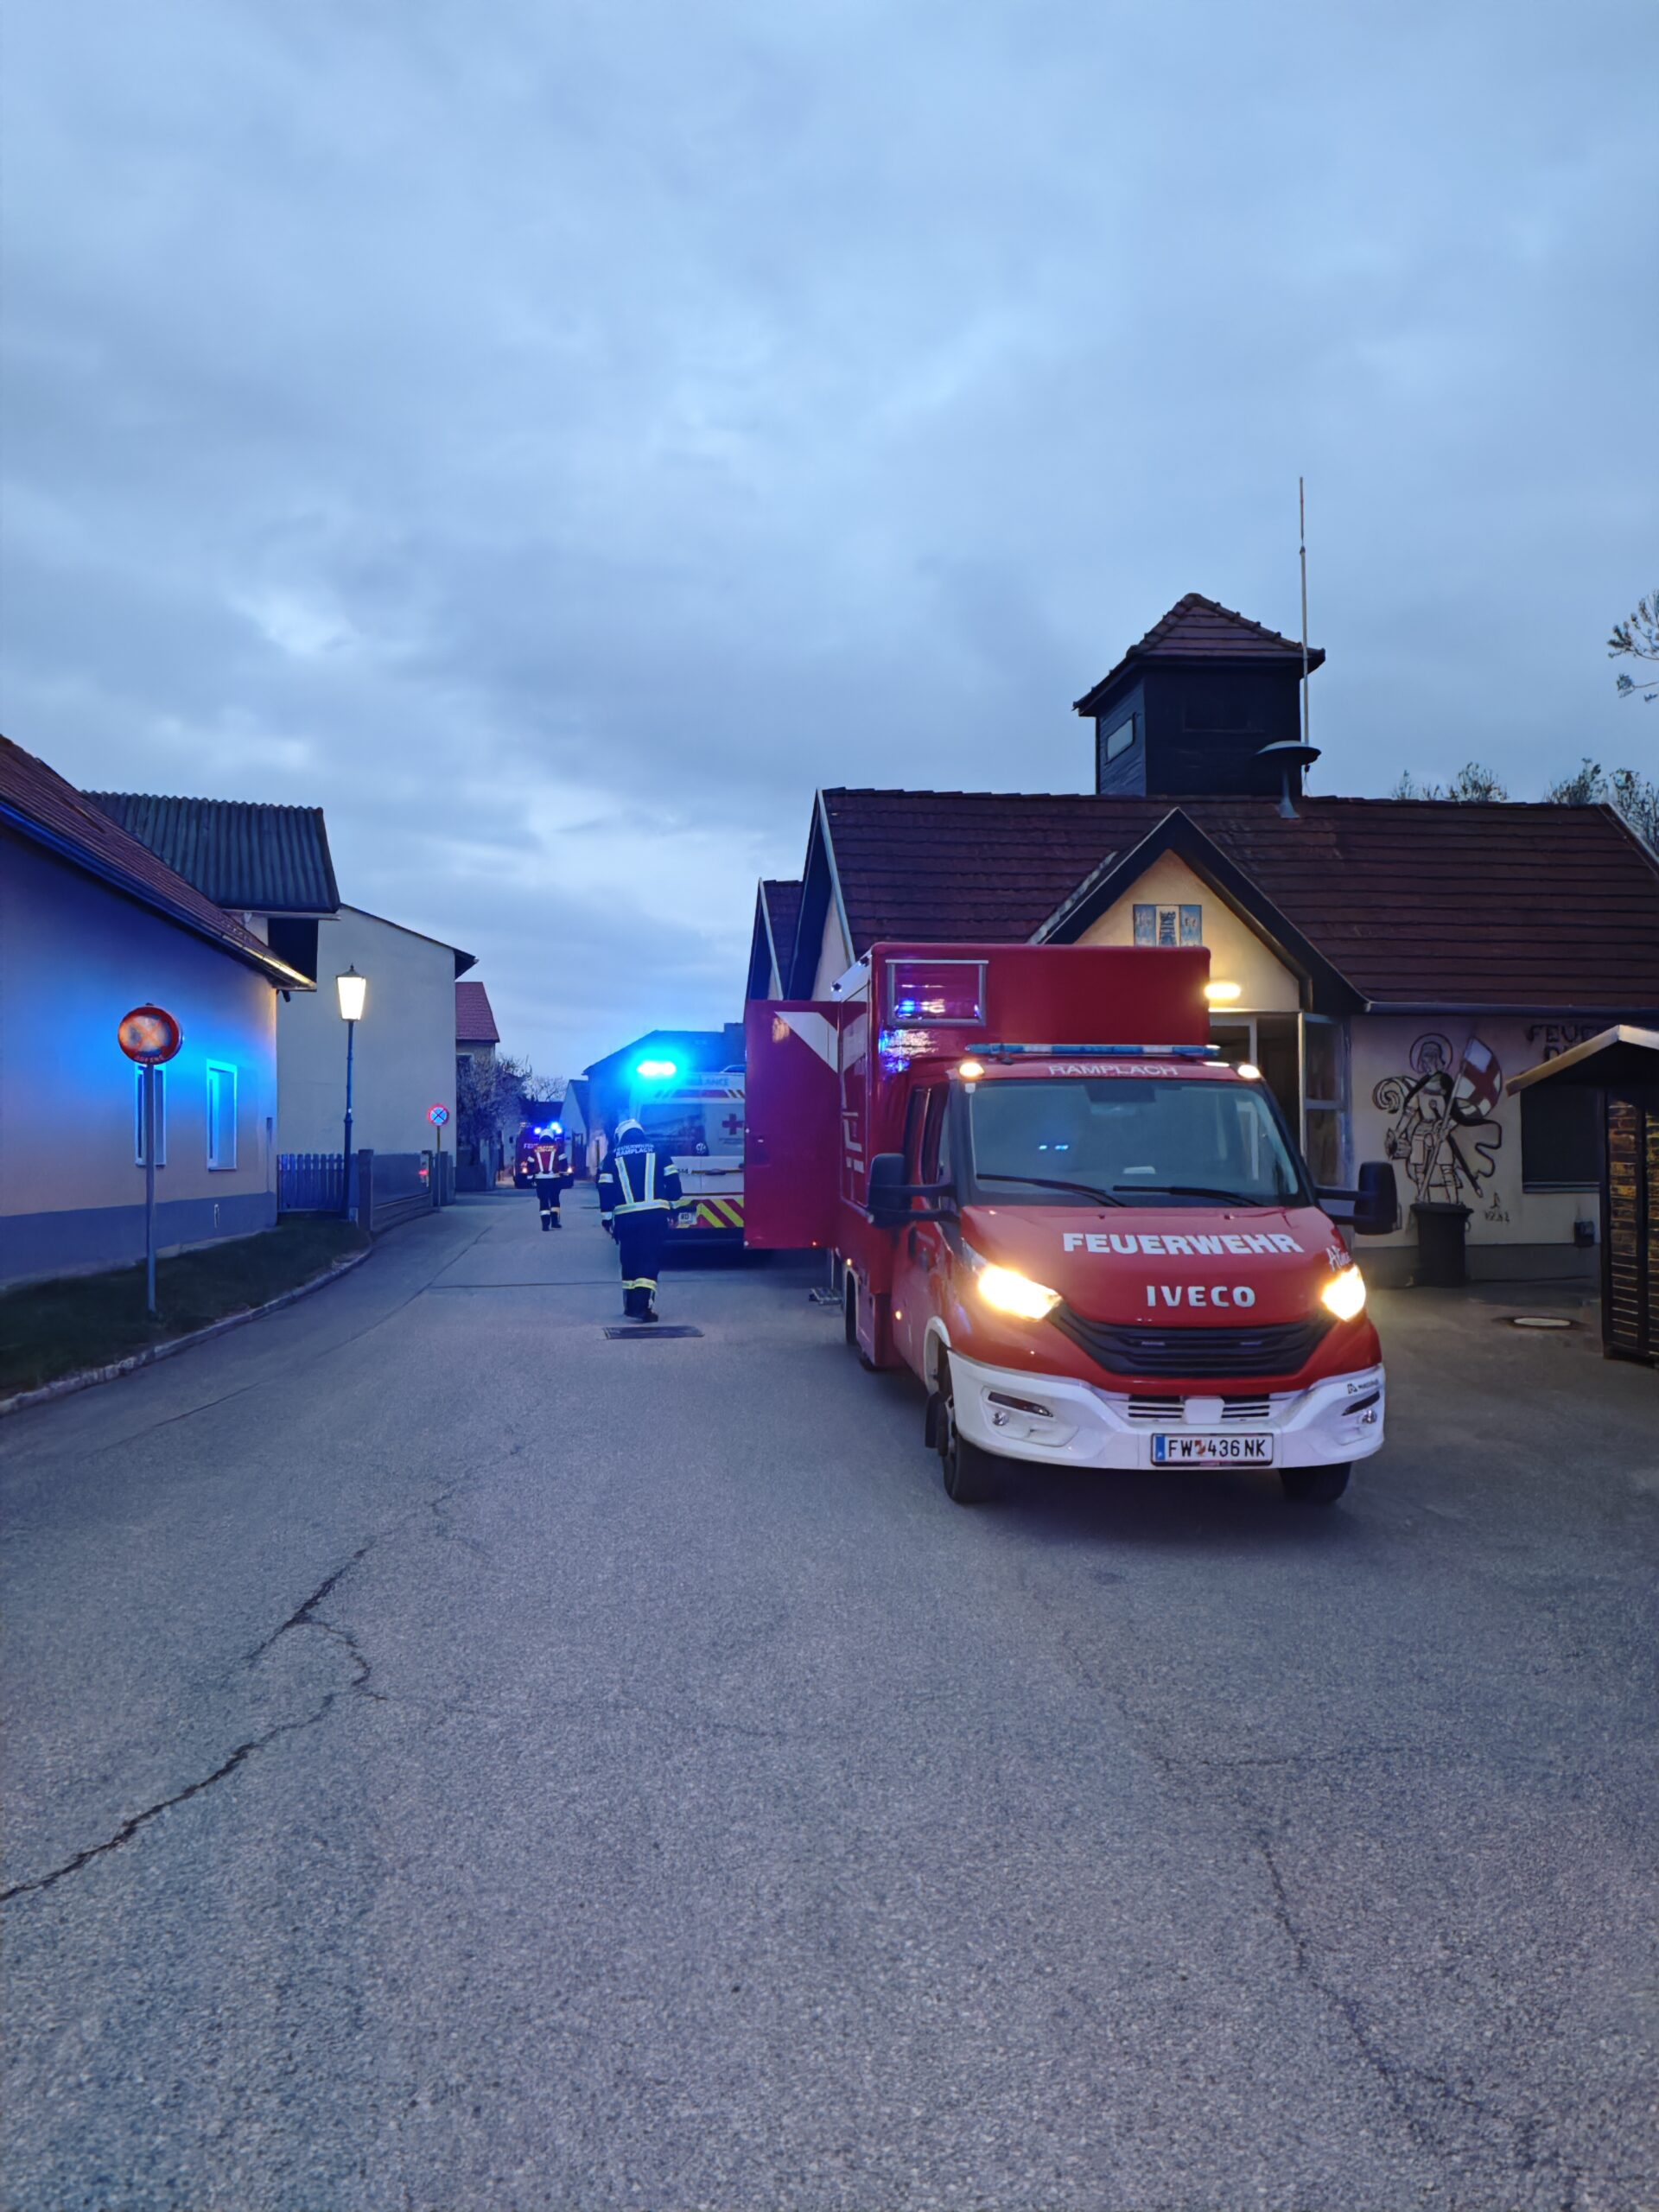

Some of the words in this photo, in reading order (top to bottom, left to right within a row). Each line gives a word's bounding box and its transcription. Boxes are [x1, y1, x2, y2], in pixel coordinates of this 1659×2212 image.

[1048, 1064, 1179, 1076] RAMPLACH
[1063, 1233, 1305, 1255] FEUERWEHR
[1147, 1286, 1256, 1307] IVECO
[1168, 1440, 1192, 1458] FW
